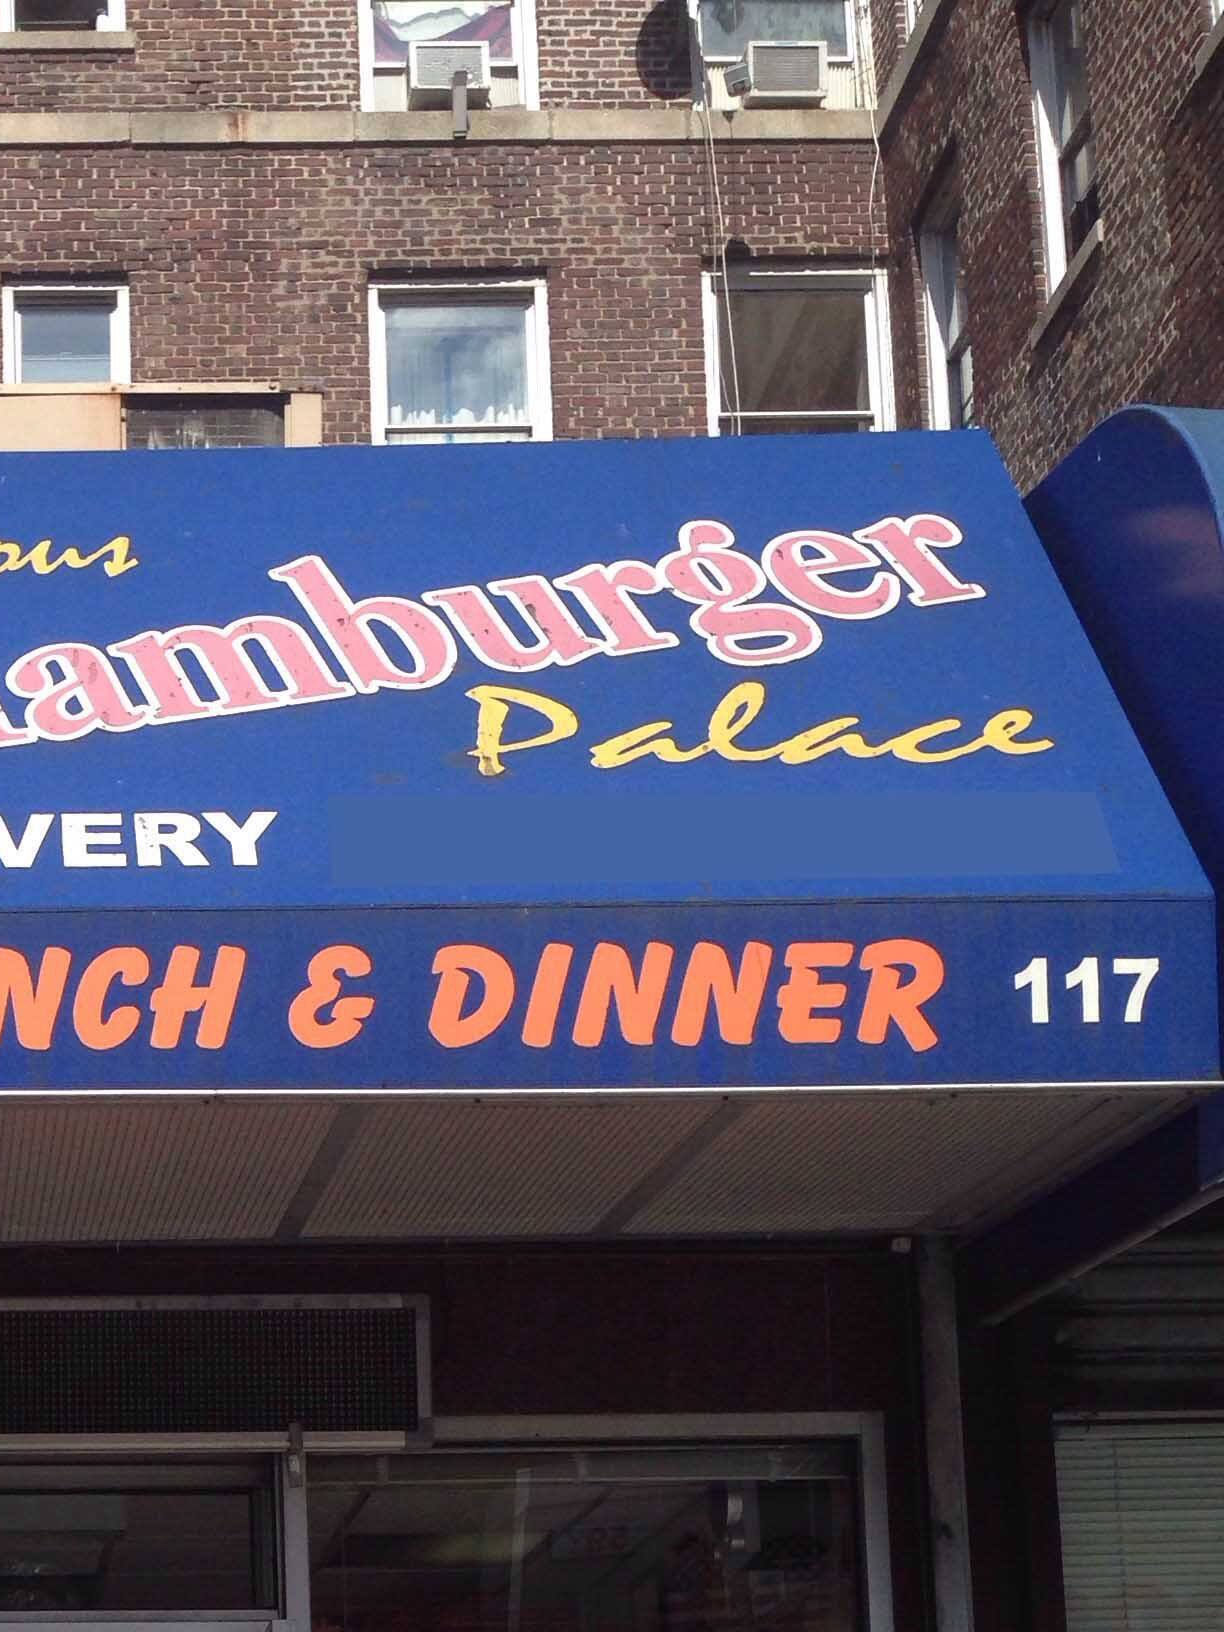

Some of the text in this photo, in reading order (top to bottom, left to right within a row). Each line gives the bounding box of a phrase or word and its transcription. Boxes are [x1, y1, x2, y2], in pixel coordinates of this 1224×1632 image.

[465, 681, 1054, 777] Palace
[287, 945, 374, 1050] &
[429, 938, 945, 1053] DINNER
[1013, 956, 1160, 1024] 117
